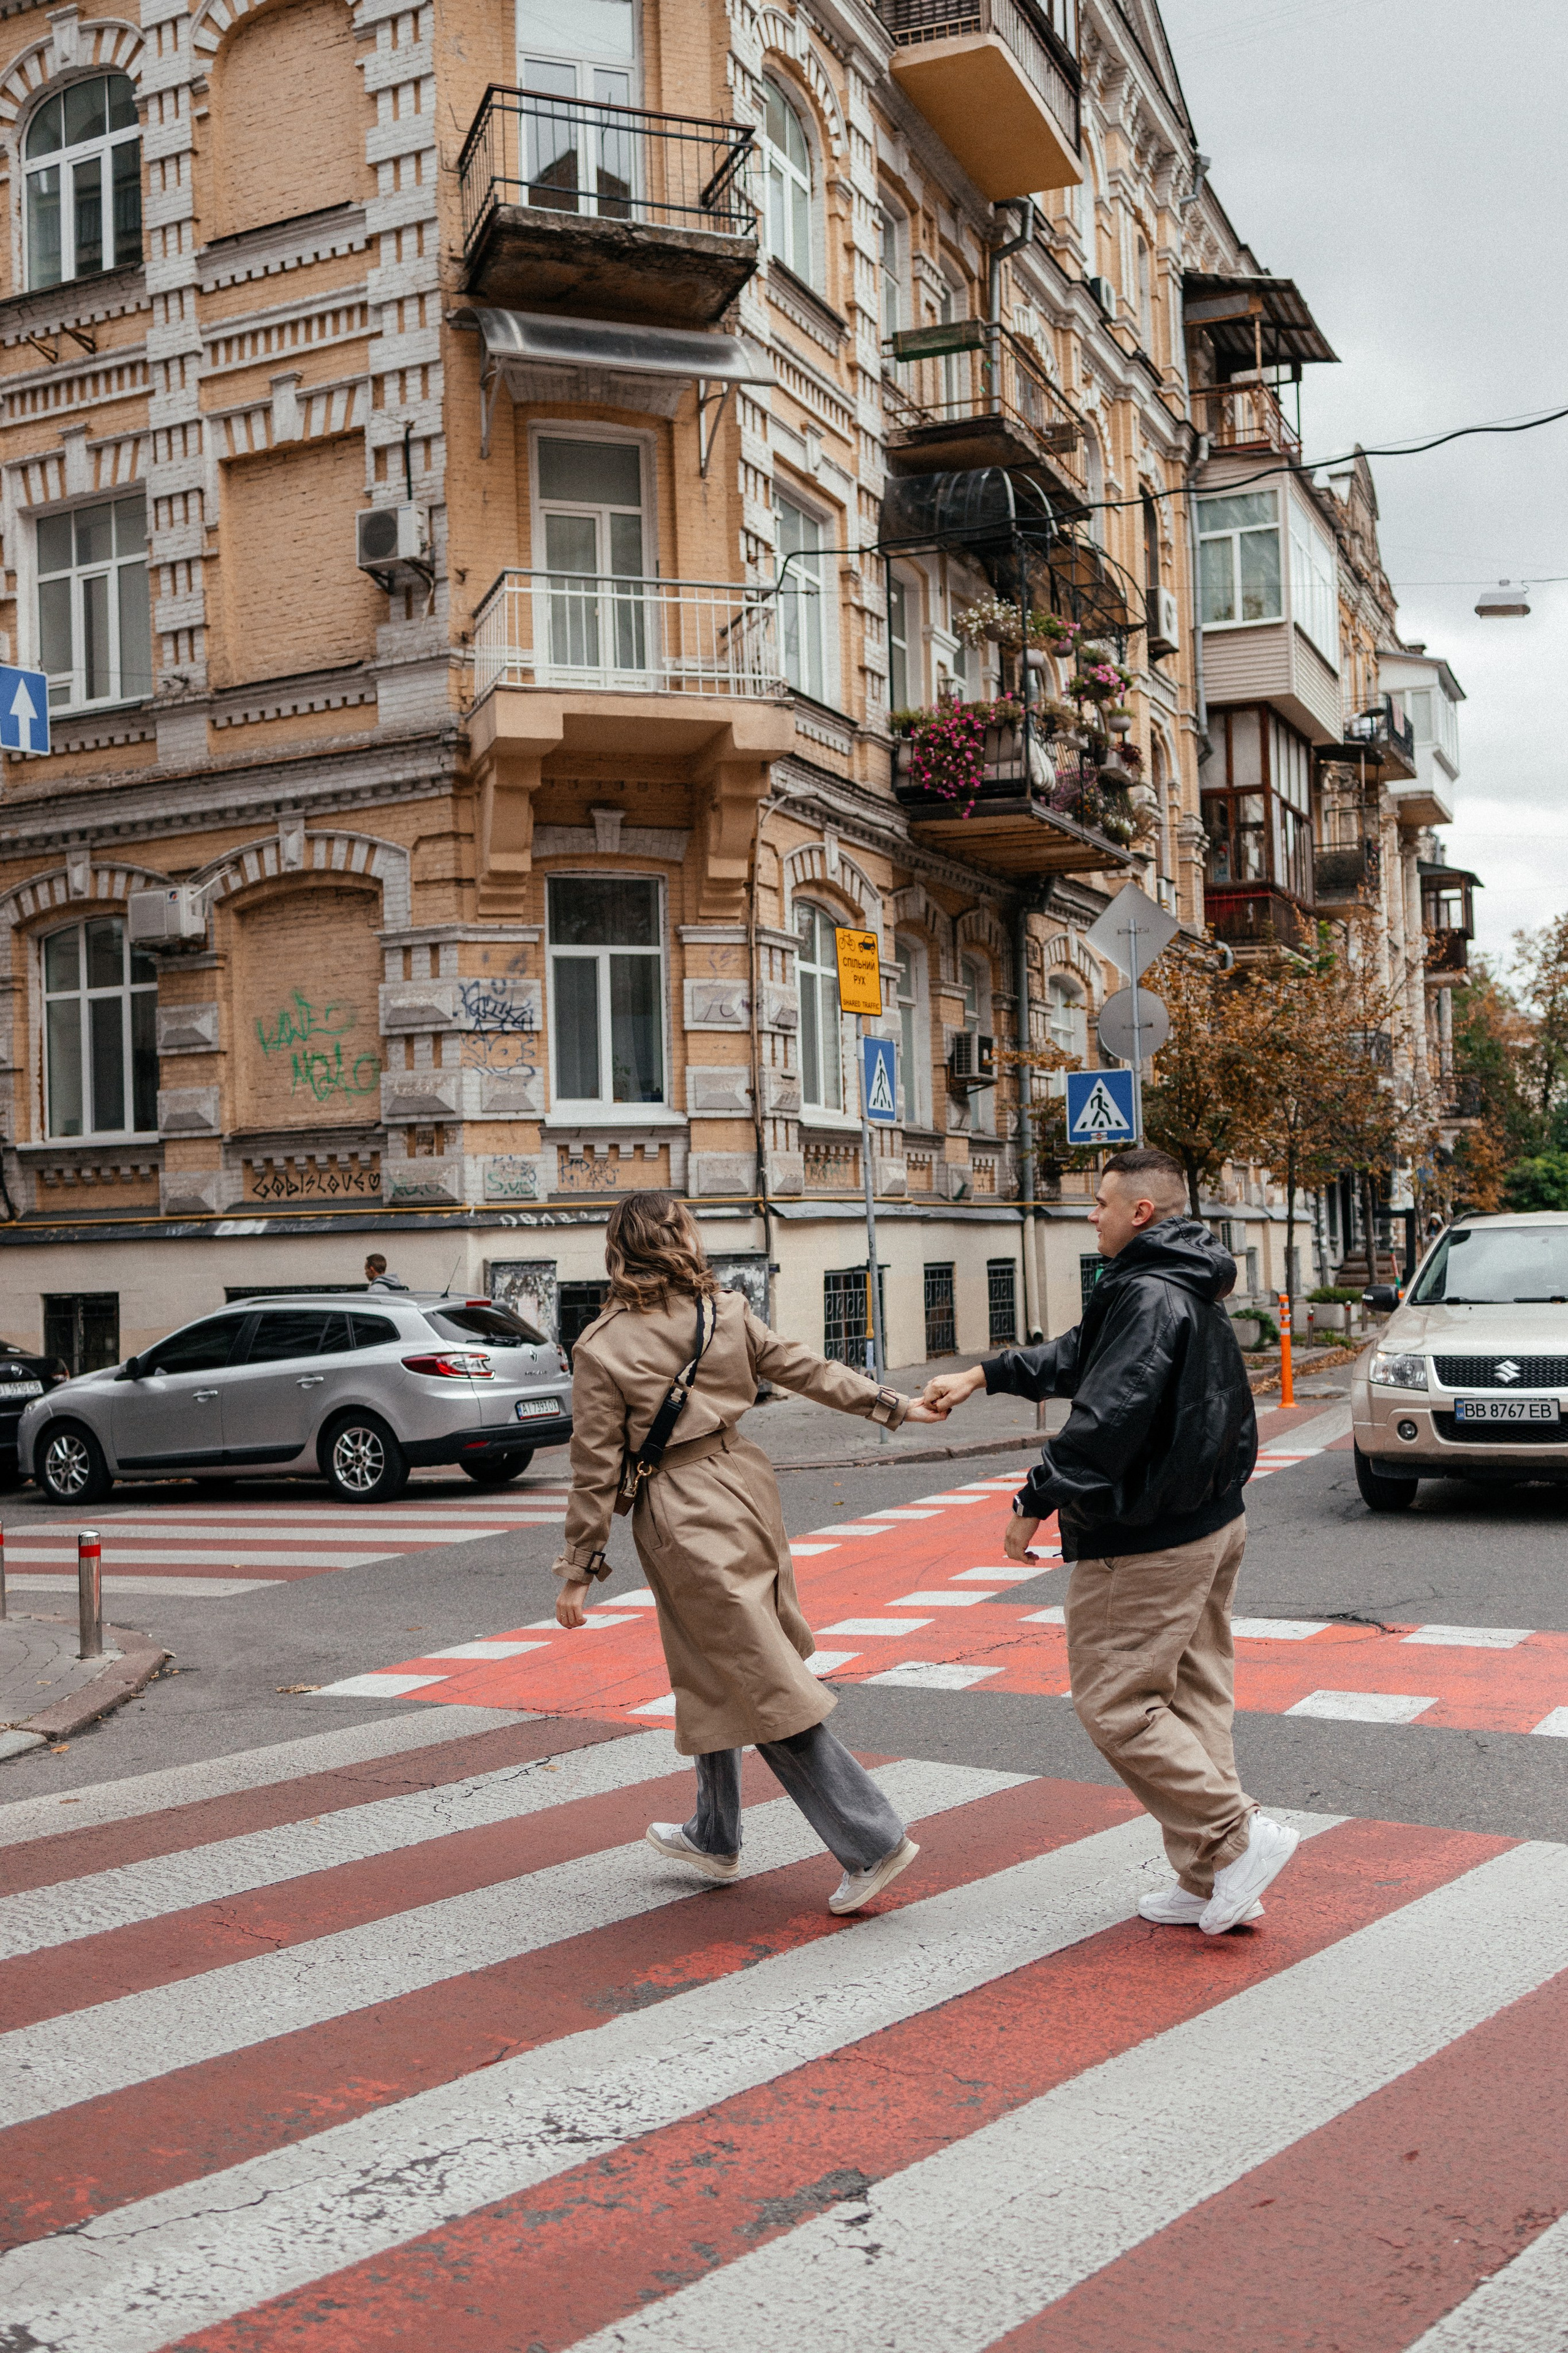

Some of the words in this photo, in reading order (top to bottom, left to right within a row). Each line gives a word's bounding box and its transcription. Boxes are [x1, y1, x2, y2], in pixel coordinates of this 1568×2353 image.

[843, 957, 875, 971] СПІЛЬНИЙ
[853, 975, 866, 986] РУХ
[843, 999, 861, 1008] SHARED
[862, 1000, 880, 1010] TRAFFIC
[522, 1403, 532, 1414] AI
[532, 1400, 548, 1413] 7393
[1464, 1403, 1486, 1418] BB
[1490, 1403, 1525, 1418] 8767
[1529, 1404, 1551, 1418] EB
